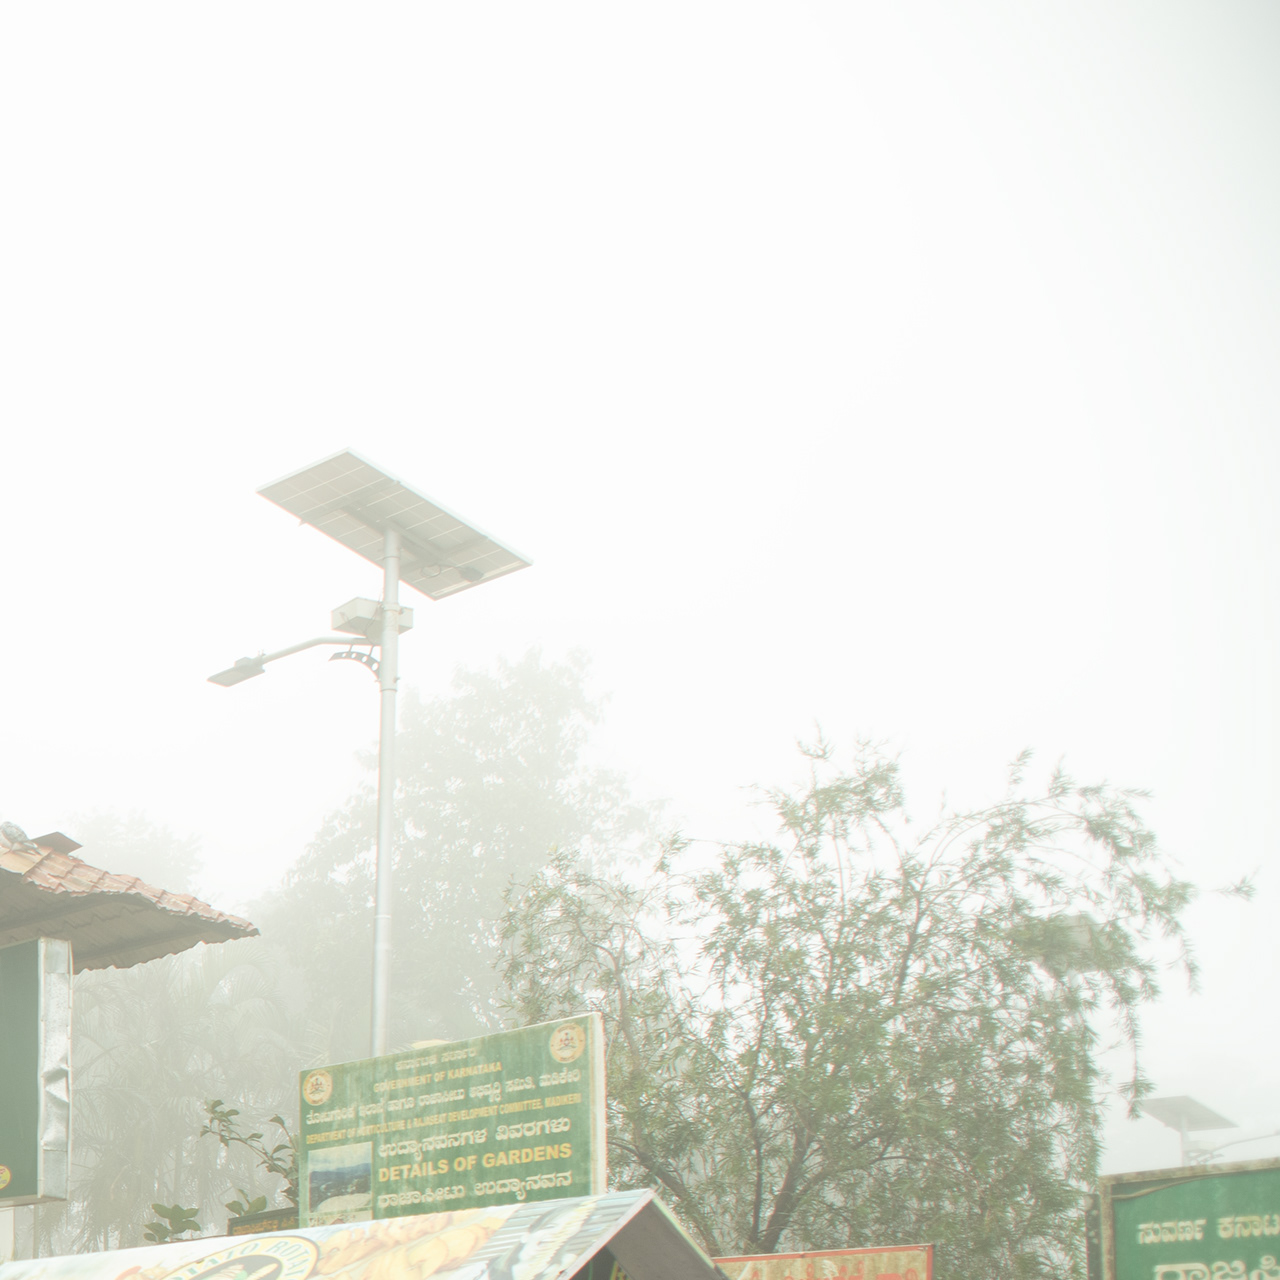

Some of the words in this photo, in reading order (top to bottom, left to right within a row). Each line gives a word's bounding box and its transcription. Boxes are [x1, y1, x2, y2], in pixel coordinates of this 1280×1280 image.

[373, 1074, 432, 1093] GOVERNMENT
[434, 1070, 446, 1082] OF
[447, 1061, 502, 1080] KARNATAKA
[448, 1105, 499, 1122] DEVELOPMENT
[495, 1117, 571, 1141] ವಿವರಗಳು
[379, 1159, 449, 1182] DETAILS
[454, 1155, 478, 1172] OF
[482, 1143, 572, 1168] GARDENS
[474, 1170, 573, 1200] ಉದ್ಯಾನವನ
